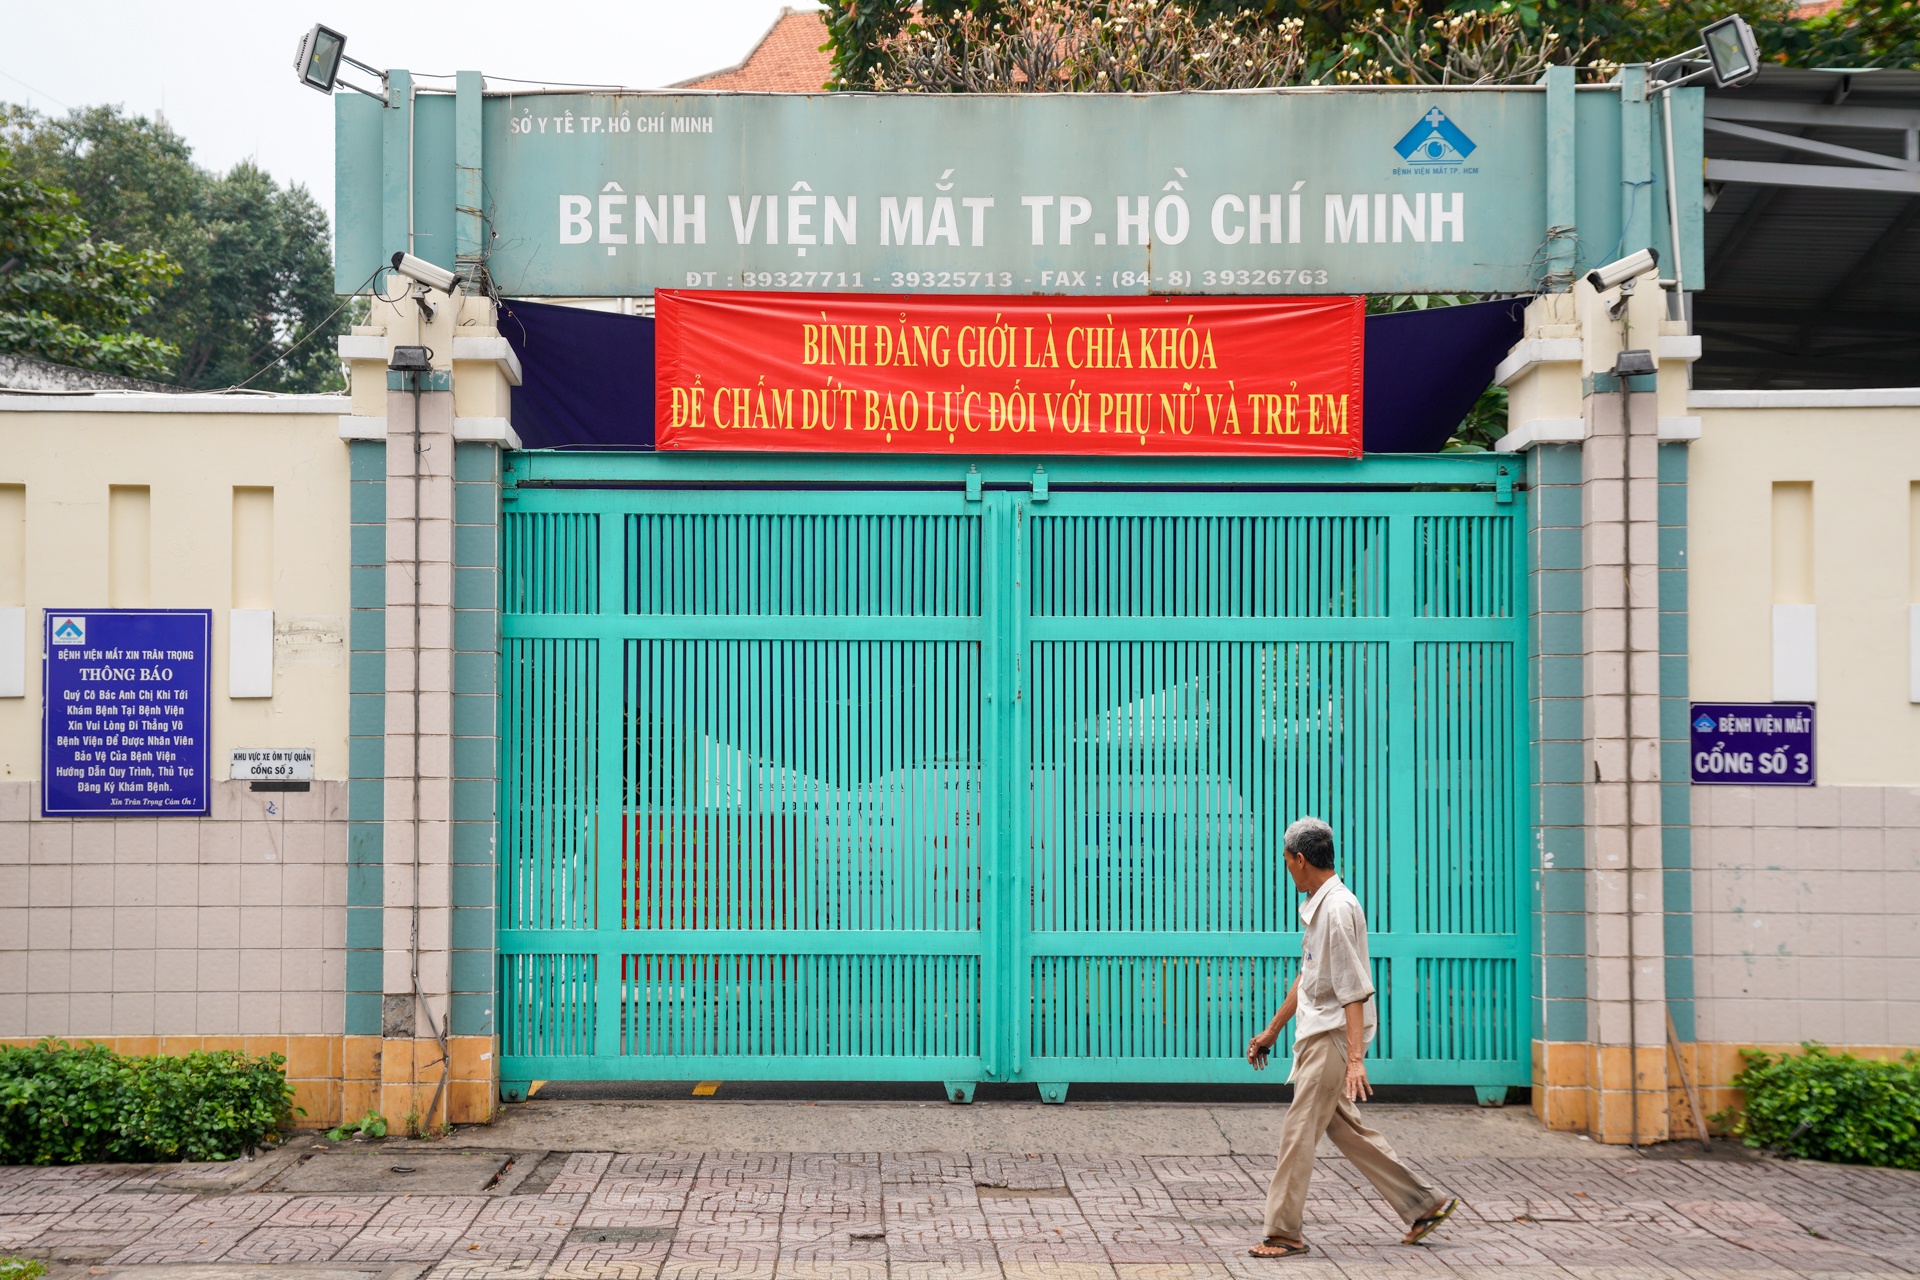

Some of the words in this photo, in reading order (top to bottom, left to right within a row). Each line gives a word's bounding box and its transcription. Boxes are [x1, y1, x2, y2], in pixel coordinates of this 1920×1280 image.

[510, 108, 532, 134] SỞ
[537, 117, 548, 134] Y
[554, 109, 574, 134] TẾ
[637, 111, 664, 133] CHÍ
[671, 116, 713, 133] MINH
[558, 181, 706, 256] BỆNH
[728, 181, 856, 257] VIỆN
[880, 168, 995, 247] MẮT
[1210, 180, 1306, 244] CHÍ
[1324, 192, 1465, 244] MINH
[686, 271, 717, 287] ĐT
[743, 271, 863, 288] 39327711
[890, 271, 1013, 288] 39325713
[1041, 270, 1086, 287] FAX
[1202, 269, 1328, 286] 39326763
[802, 310, 868, 366] BÌNH
[874, 312, 950, 368] ĐẲNG
[957, 313, 1017, 368] GIỚI
[1024, 313, 1060, 369] LÀ
[1066, 314, 1134, 369] CHÌA
[1138, 314, 1218, 370] KHÓA
[670, 374, 706, 429] ĐỂ
[713, 375, 795, 430] CHẤM
[801, 376, 857, 431] DỨT
[864, 389, 919, 443] BẠO
[926, 384, 981, 444] LỰC
[988, 379, 1037, 433] ĐỐI
[1043, 379, 1091, 434] VỚI
[1098, 394, 1153, 446] PHỤ
[1158, 382, 1201, 435] NỮ
[1204, 380, 1241, 435] VÀ
[1248, 380, 1300, 435] TRẺ
[1306, 394, 1350, 435] EM
[57, 649, 81, 662] BỆNH
[83, 649, 103, 662] VIỆN
[105, 647, 123, 660] MẮT
[125, 650, 140, 660] XIN
[142, 649, 164, 660] TRÂN
[166, 650, 194, 662] TRỌNG
[79, 664, 136, 681] THÔNG
[139, 664, 173, 681] BÁO
[63, 689, 81, 702] Quý
[83, 689, 96, 700] Cô
[99, 689, 116, 700] Bác
[118, 689, 136, 700] Anh
[138, 689, 153, 702] Chị
[156, 689, 171, 700] Khi
[173, 689, 189, 700] Tới
[66, 705, 92, 715] Khám
[95, 705, 118, 717] Bệnh
[121, 705, 135, 717] Tại
[138, 705, 161, 717] Bệnh
[164, 705, 184, 717] Viện
[67, 720, 83, 731] Xin
[85, 720, 100, 731] Vui
[103, 720, 125, 733] Lòng
[128, 720, 138, 731] Đi
[141, 718, 169, 733] Thẳng
[171, 720, 184, 732] Vô
[1718, 713, 1753, 736] BỆNH
[1753, 713, 1783, 736] VIỆN
[1784, 711, 1812, 734] MẮT
[56, 735, 80, 747] Bệnh
[82, 735, 103, 747] Viện
[105, 733, 119, 746] Để
[121, 735, 144, 748] Được
[147, 736, 171, 746] Nhân
[173, 736, 194, 746] Viên
[74, 750, 92, 761] Bảo
[95, 751, 107, 763] Vệ
[110, 750, 127, 761] Của
[130, 751, 153, 763] Bệnh
[155, 751, 177, 763] Viện
[233, 752, 247, 761] KHU
[262, 753, 271, 761] XE
[1694, 741, 1754, 774] CỔNG
[1757, 744, 1790, 775] SỐ
[1793, 752, 1809, 775] 3
[56, 766, 85, 778] Hướng
[88, 764, 106, 777] Dẫn
[109, 766, 126, 778] Quy
[128, 766, 155, 778] Trình,
[158, 765, 175, 777] Thủ
[177, 766, 194, 778] Tục
[250, 762, 273, 775] CỔNG
[274, 763, 286, 775] SỐ
[288, 766, 294, 775] 3
[77, 781, 101, 793] Đăng
[104, 782, 115, 794] Ký
[118, 782, 144, 792] Khám
[147, 781, 173, 794] Bệnh.
